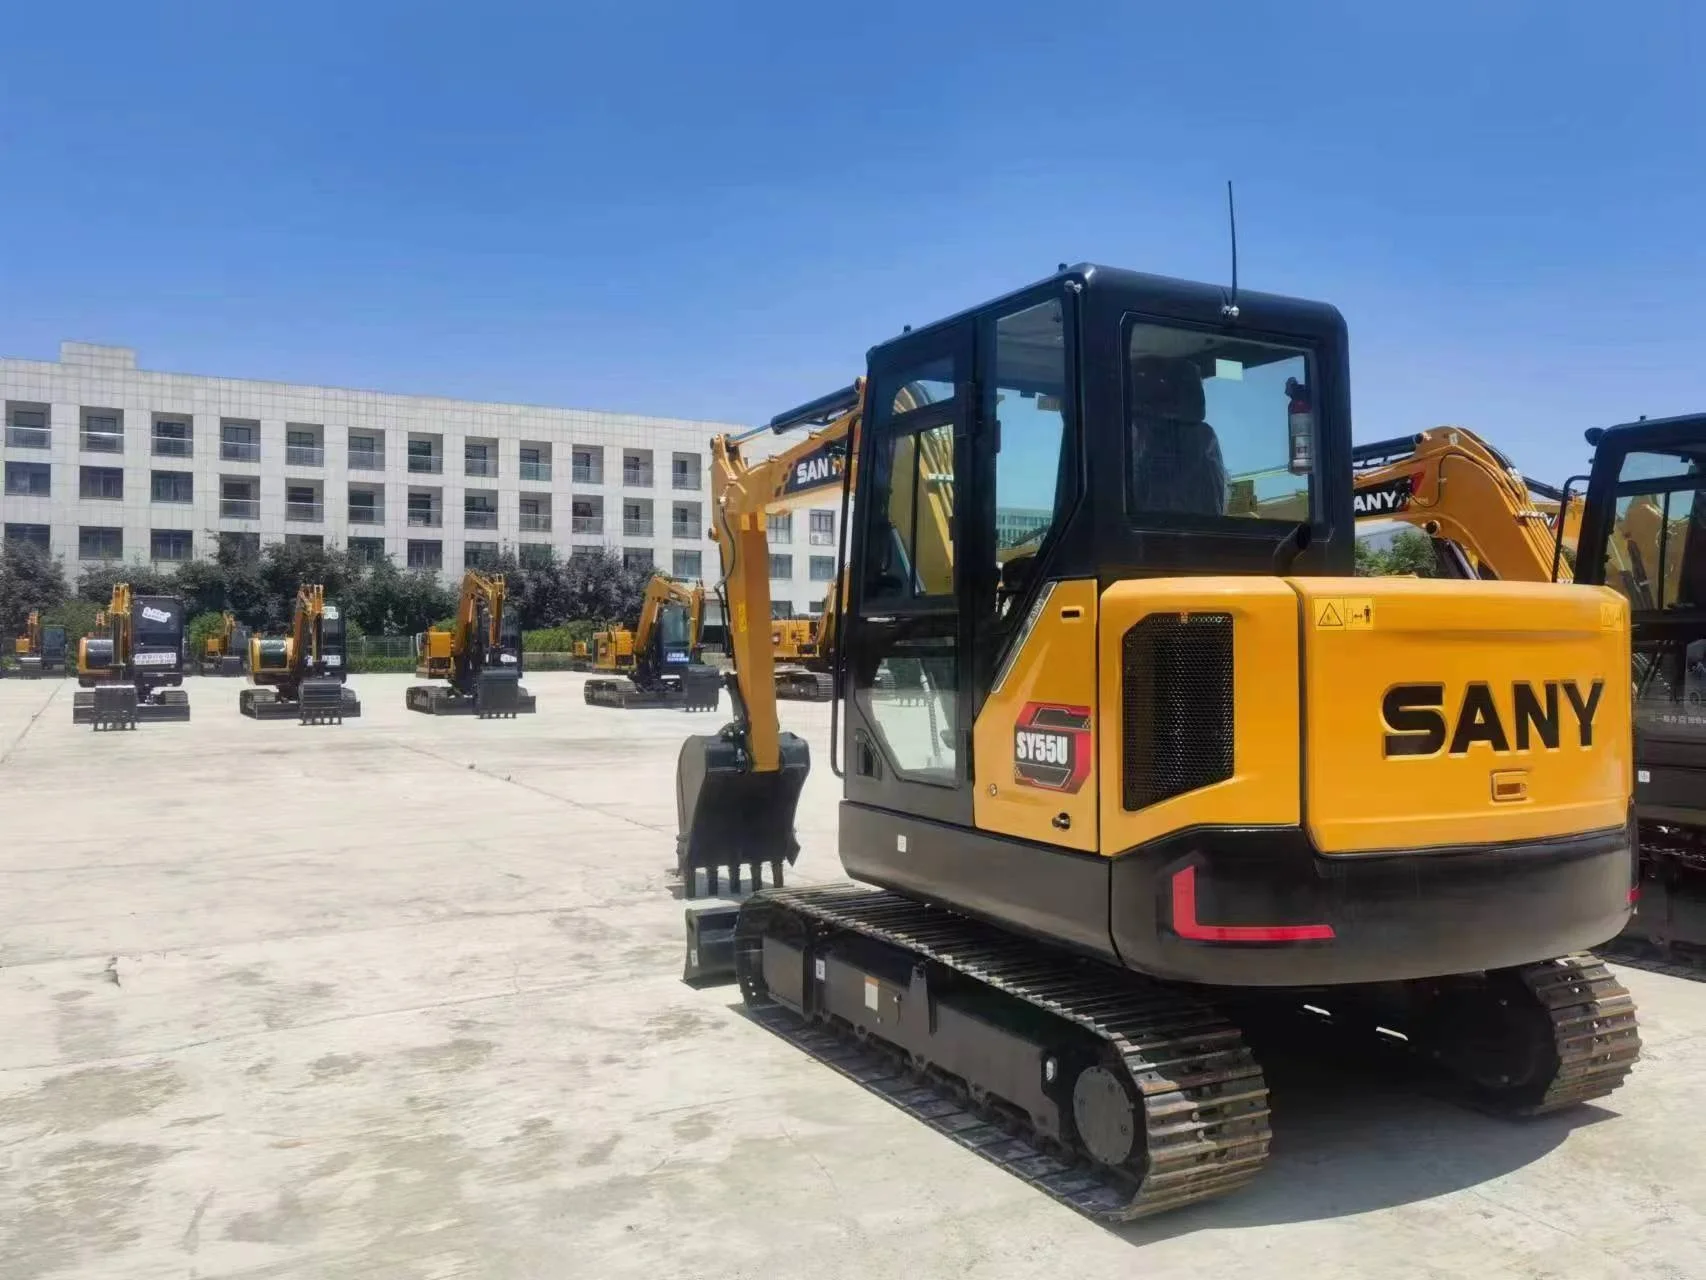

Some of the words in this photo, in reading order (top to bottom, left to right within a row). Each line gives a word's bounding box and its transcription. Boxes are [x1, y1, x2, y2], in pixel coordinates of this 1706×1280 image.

[1353, 490, 1397, 512] ANY
[1381, 680, 1604, 758] SANY
[1016, 731, 1068, 765] SY55U
